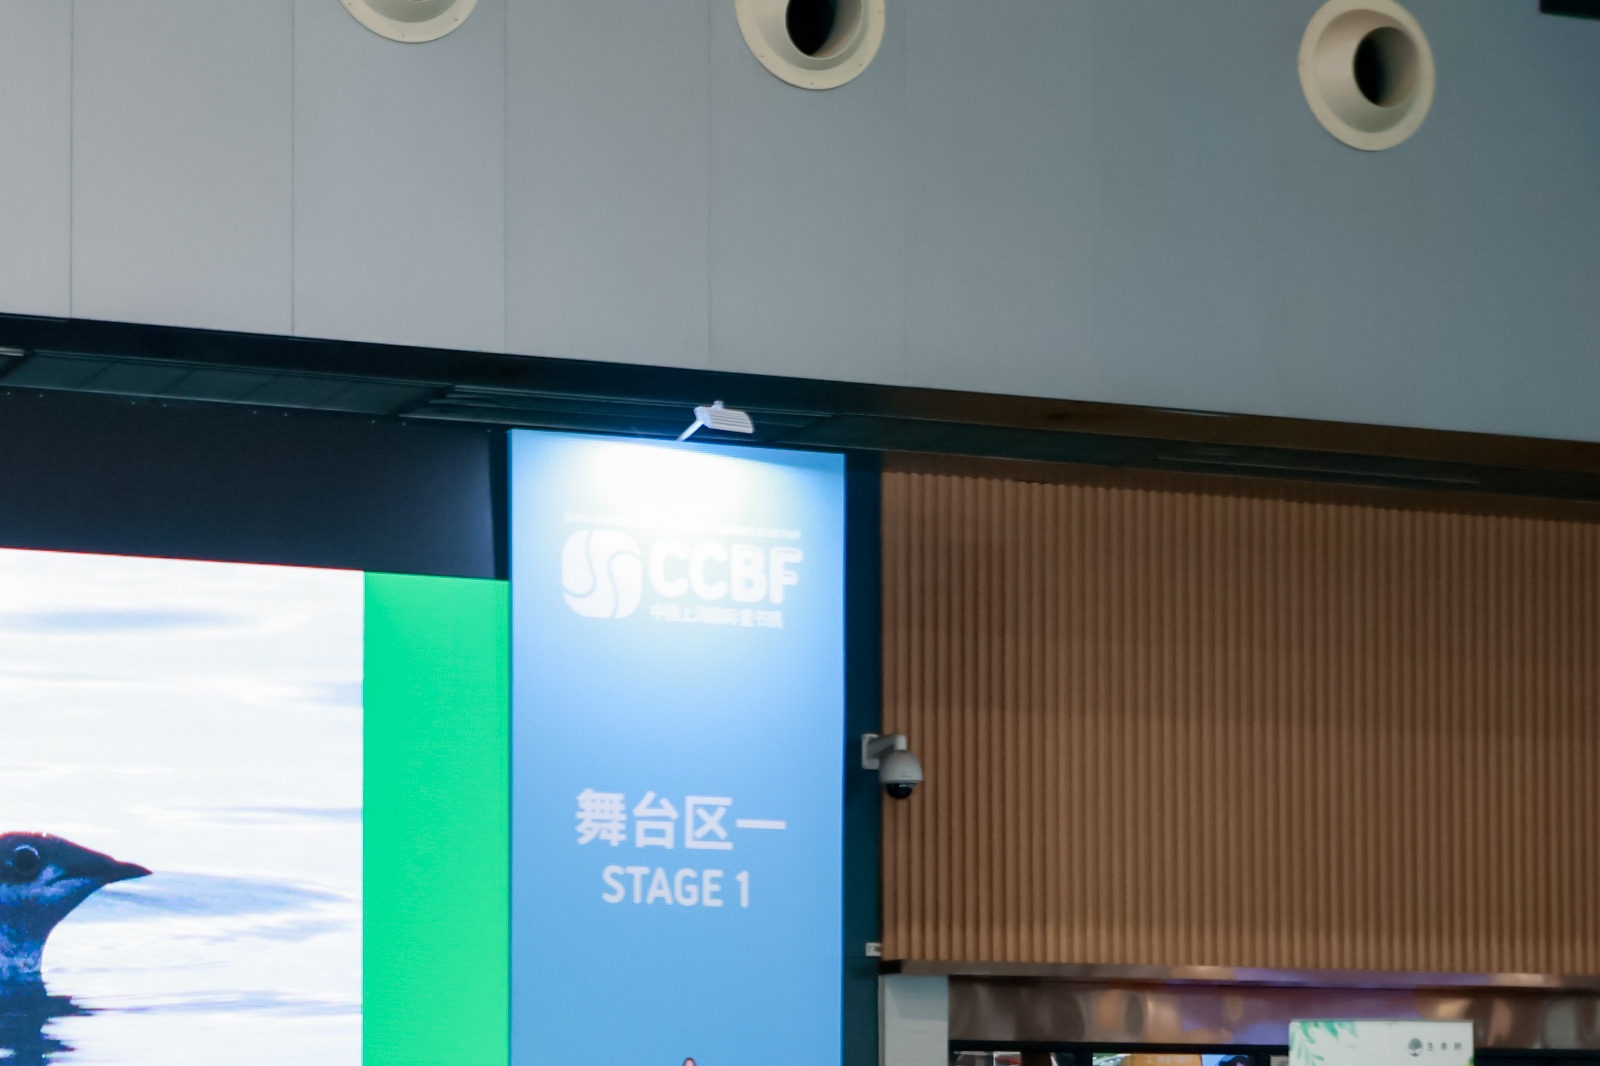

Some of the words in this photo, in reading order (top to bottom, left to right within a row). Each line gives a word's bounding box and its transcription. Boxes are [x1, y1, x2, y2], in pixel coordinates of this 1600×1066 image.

[650, 537, 803, 605] CCBF
[575, 788, 787, 850] 舞台区一
[602, 865, 723, 907] STAGE
[736, 871, 750, 908] 1
